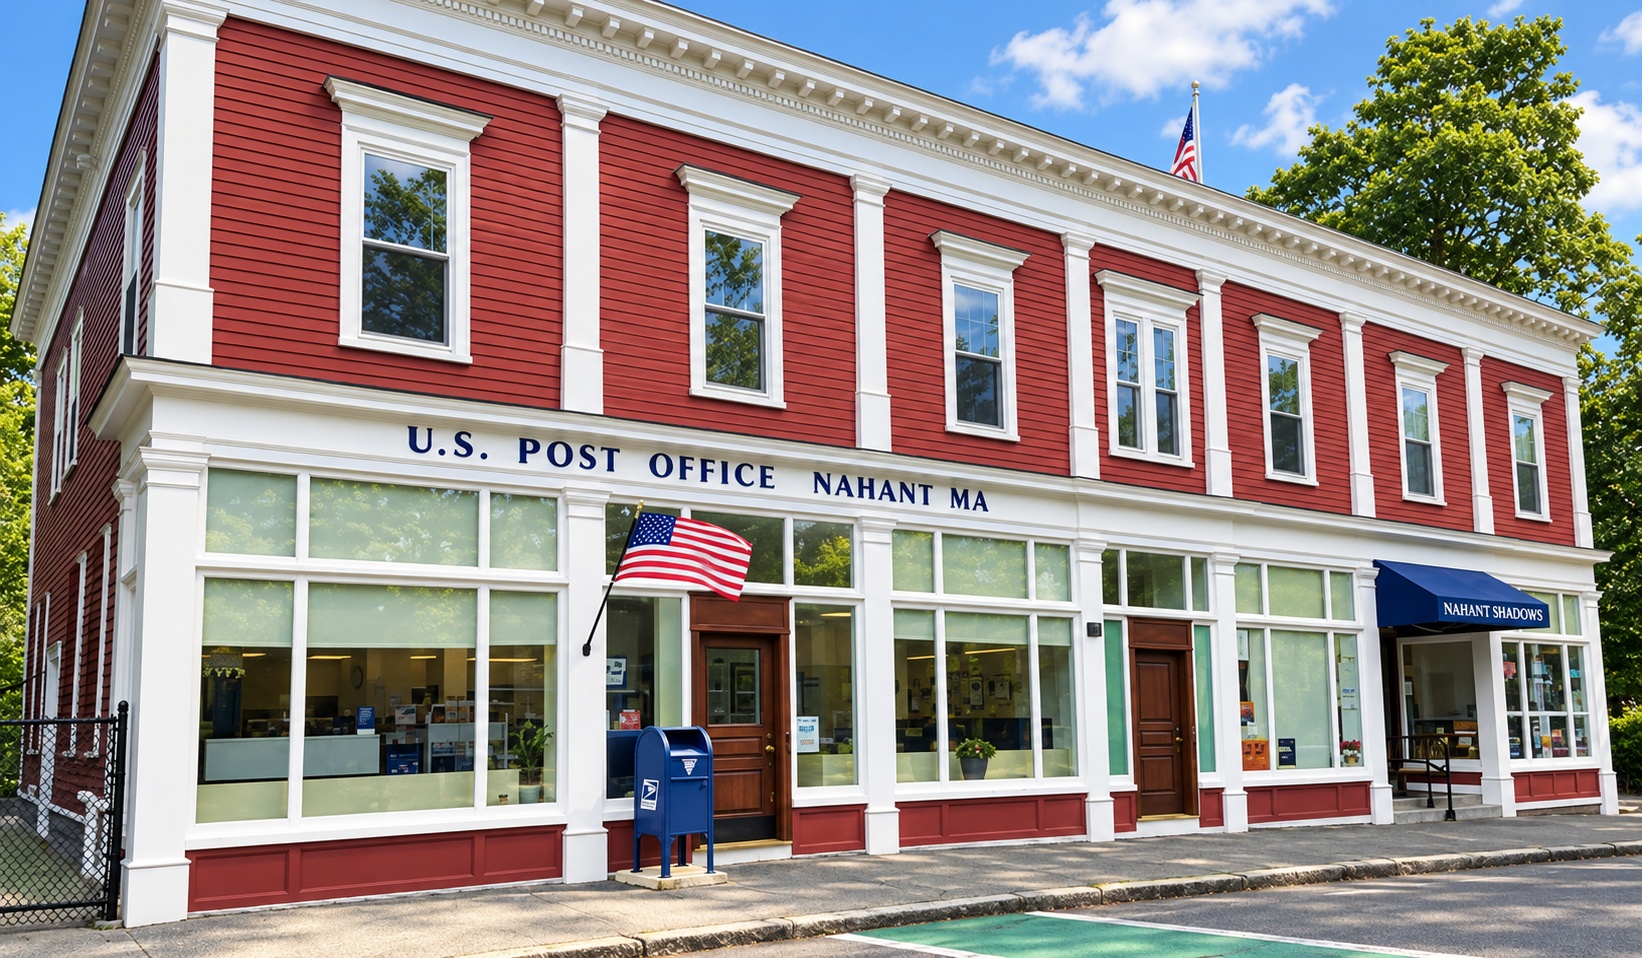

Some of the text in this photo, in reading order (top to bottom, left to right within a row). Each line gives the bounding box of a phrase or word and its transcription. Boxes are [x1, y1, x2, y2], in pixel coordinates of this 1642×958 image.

[408, 426, 990, 512] U.S. POST OFFICE NAHANT MA
[1443, 602, 1543, 622] NAHANT SHADOWS
